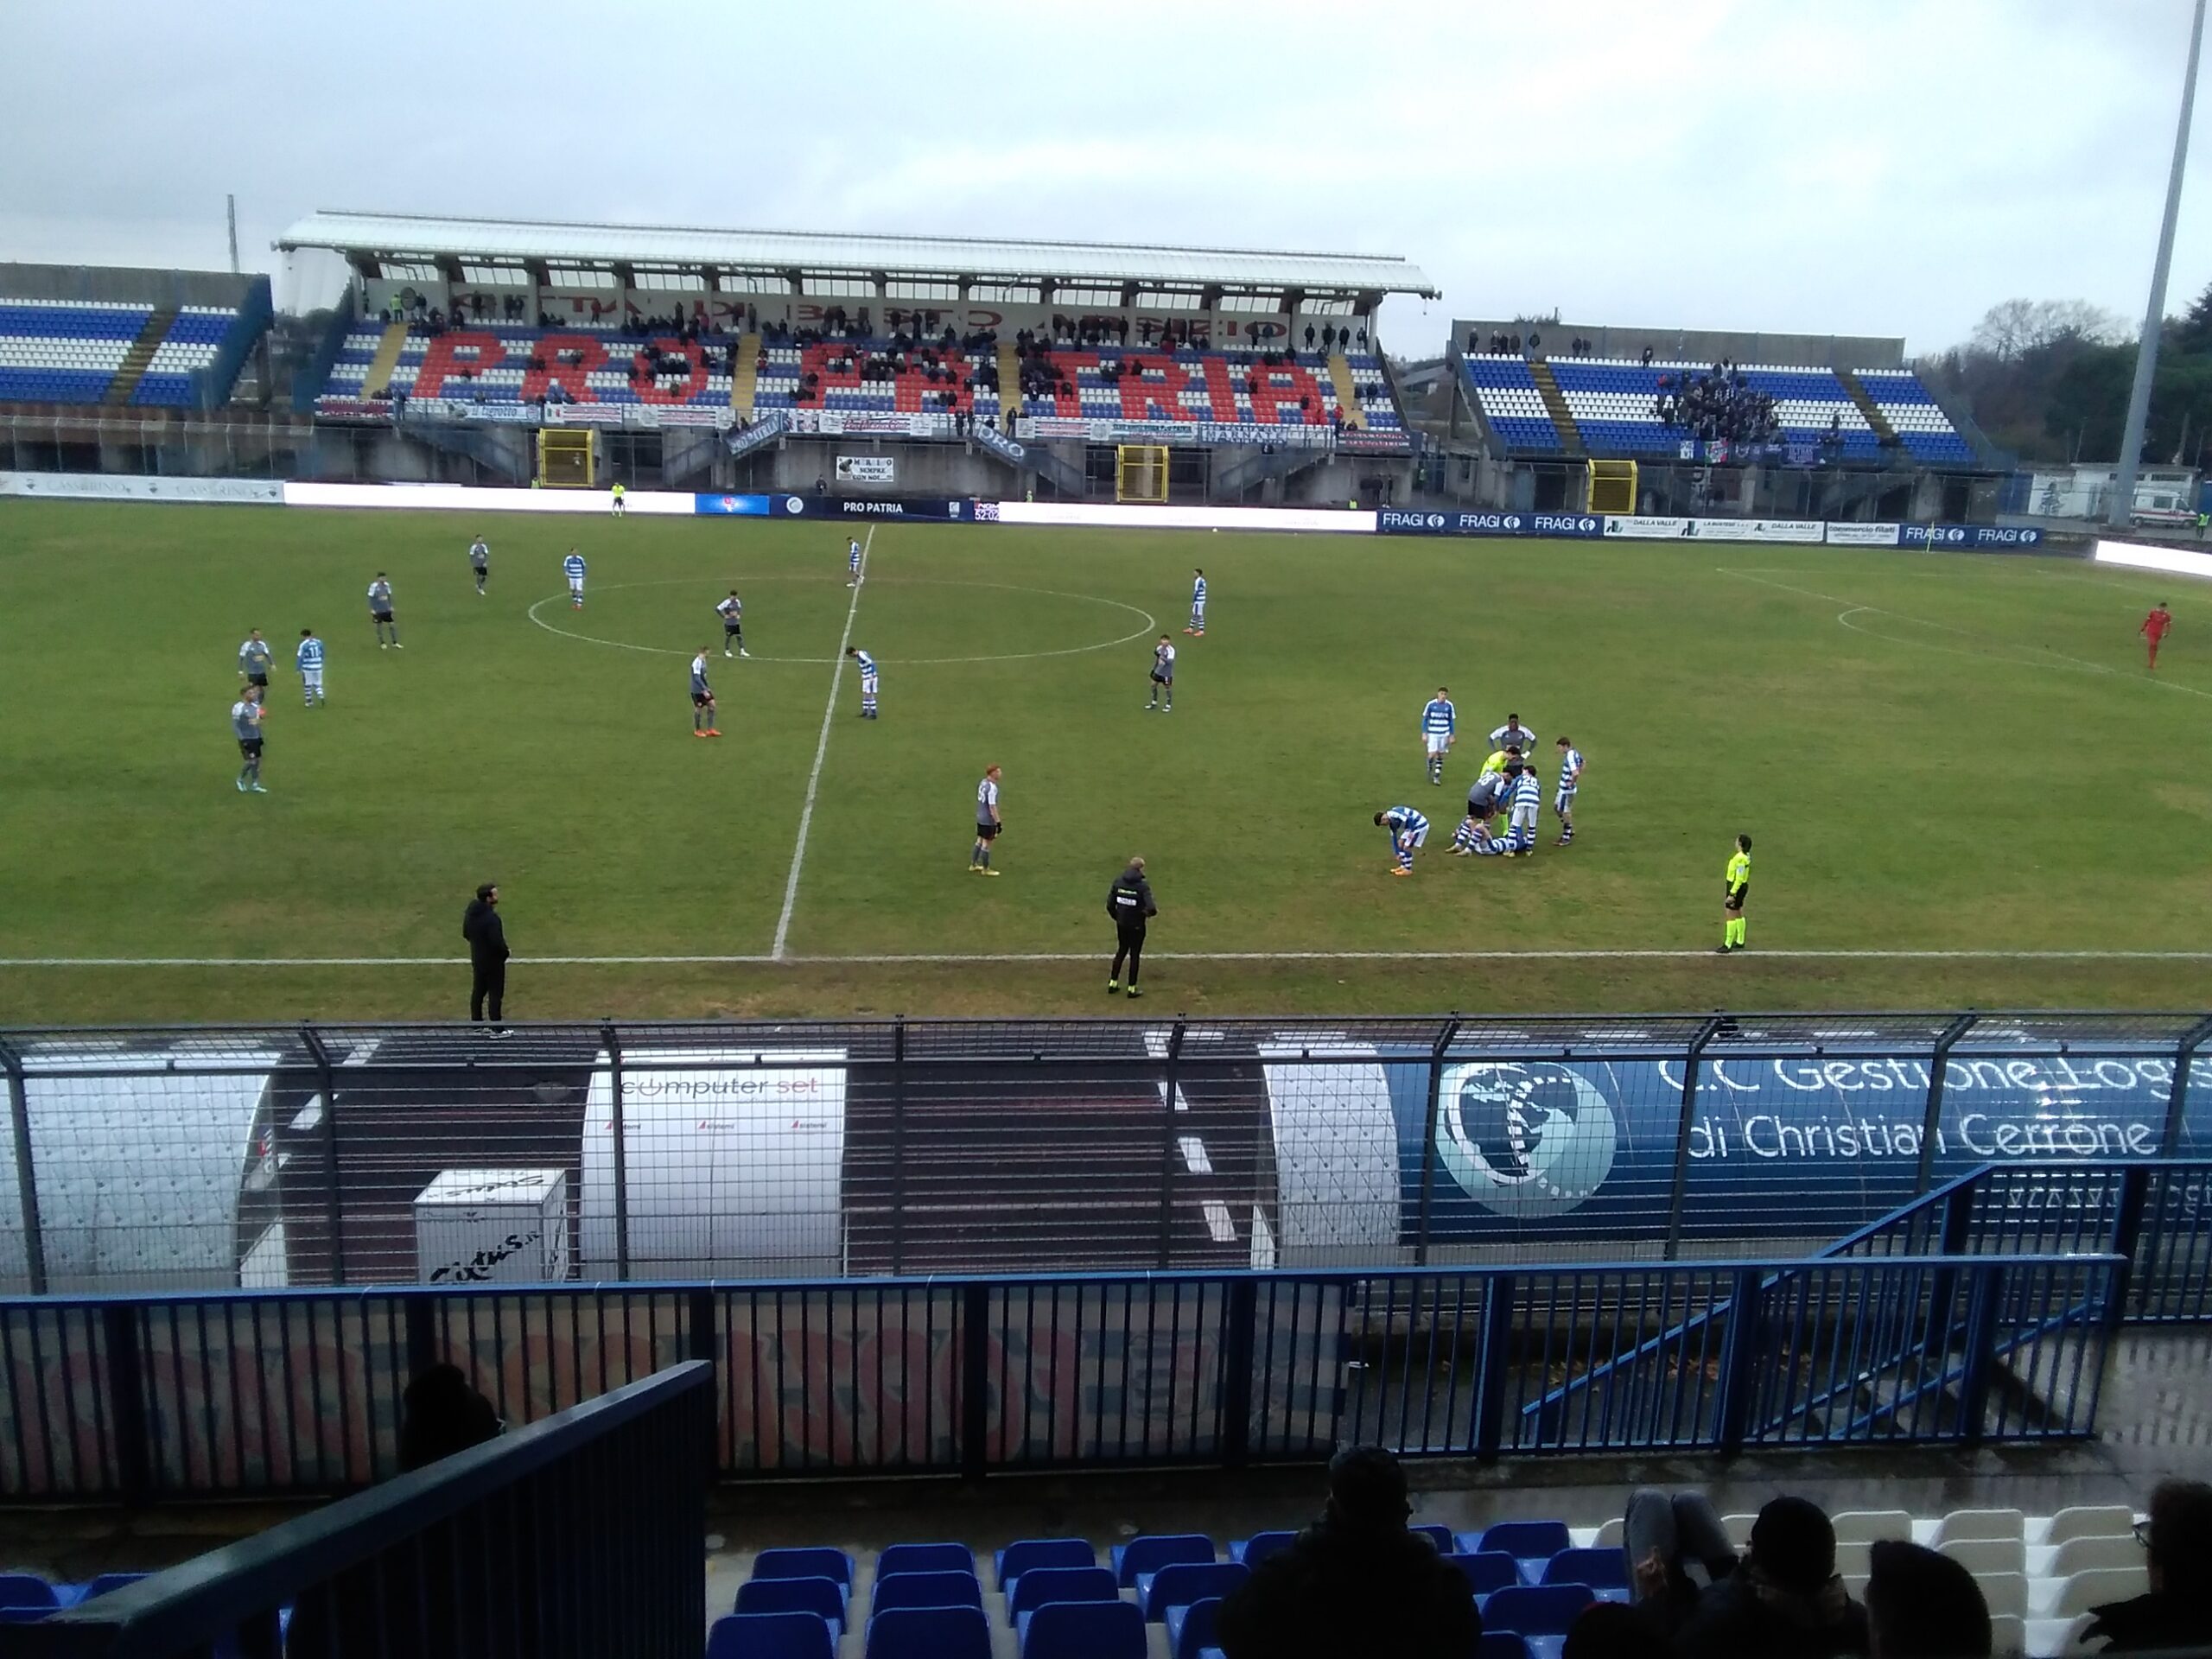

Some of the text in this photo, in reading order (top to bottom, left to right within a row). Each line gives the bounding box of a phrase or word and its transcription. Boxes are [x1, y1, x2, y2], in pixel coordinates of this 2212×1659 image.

[843, 501, 904, 513] PRO PATRIA
[1382, 513, 1424, 528] FRAGI
[1459, 515, 1500, 529] FRAGI
[1535, 517, 1575, 531] FRAGI
[1906, 526, 1945, 541] FRAGI
[1978, 529, 2018, 543] FRAGI
[776, 1077, 819, 1094] set
[1688, 1116, 1728, 1158] di
[1959, 1114, 2158, 1156] Cerrone
